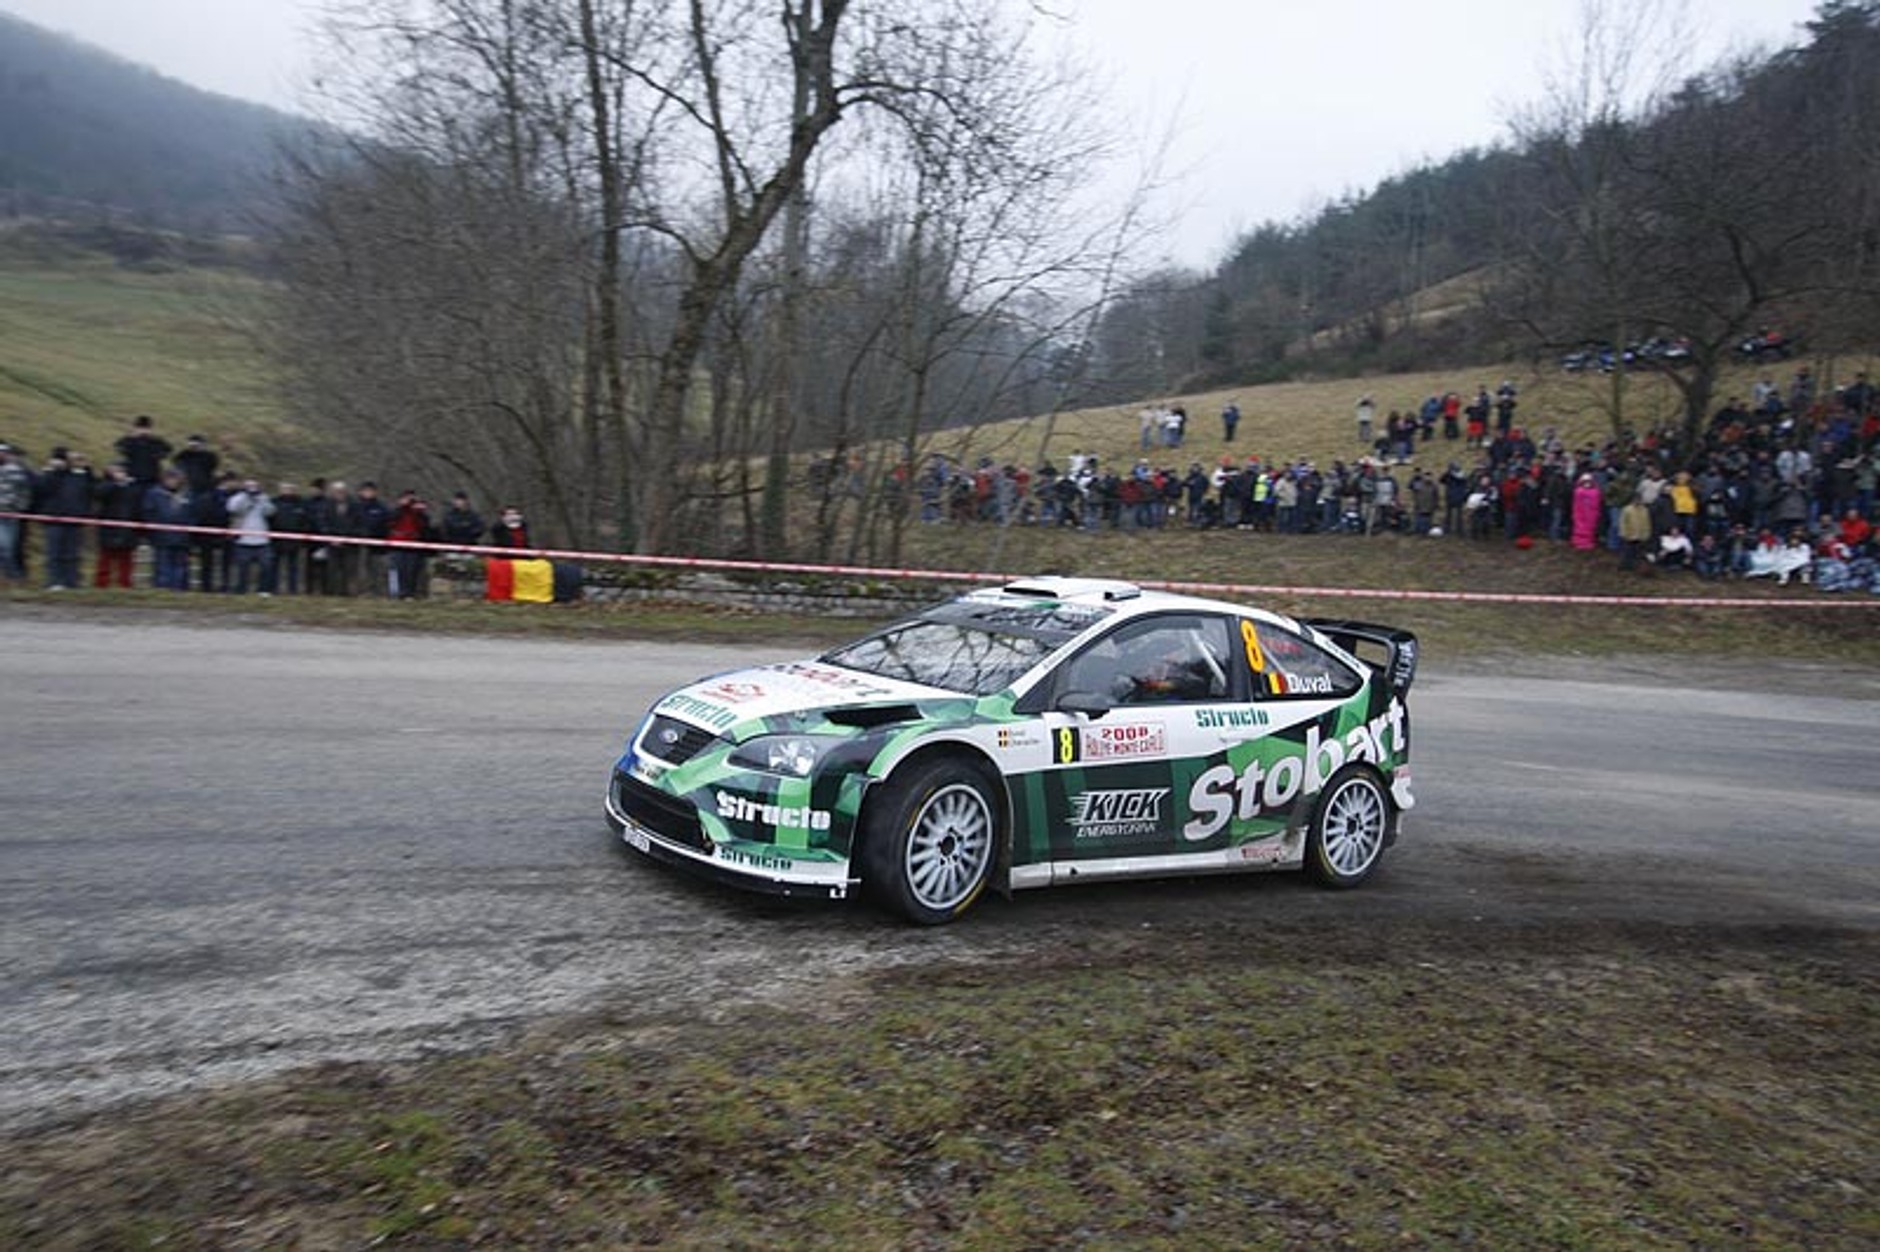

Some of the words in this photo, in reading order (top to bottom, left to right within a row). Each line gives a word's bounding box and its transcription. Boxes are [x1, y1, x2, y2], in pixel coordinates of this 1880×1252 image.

[1241, 620, 1265, 673] 8
[1286, 671, 1334, 694] Duval
[1101, 726, 1149, 741] 2008
[1195, 708, 1270, 728] Structo
[1059, 725, 1073, 764] 8
[1182, 695, 1406, 841] Stobart
[715, 790, 832, 830] Structo
[1080, 789, 1168, 823] KICK
[720, 849, 792, 871] Structo
